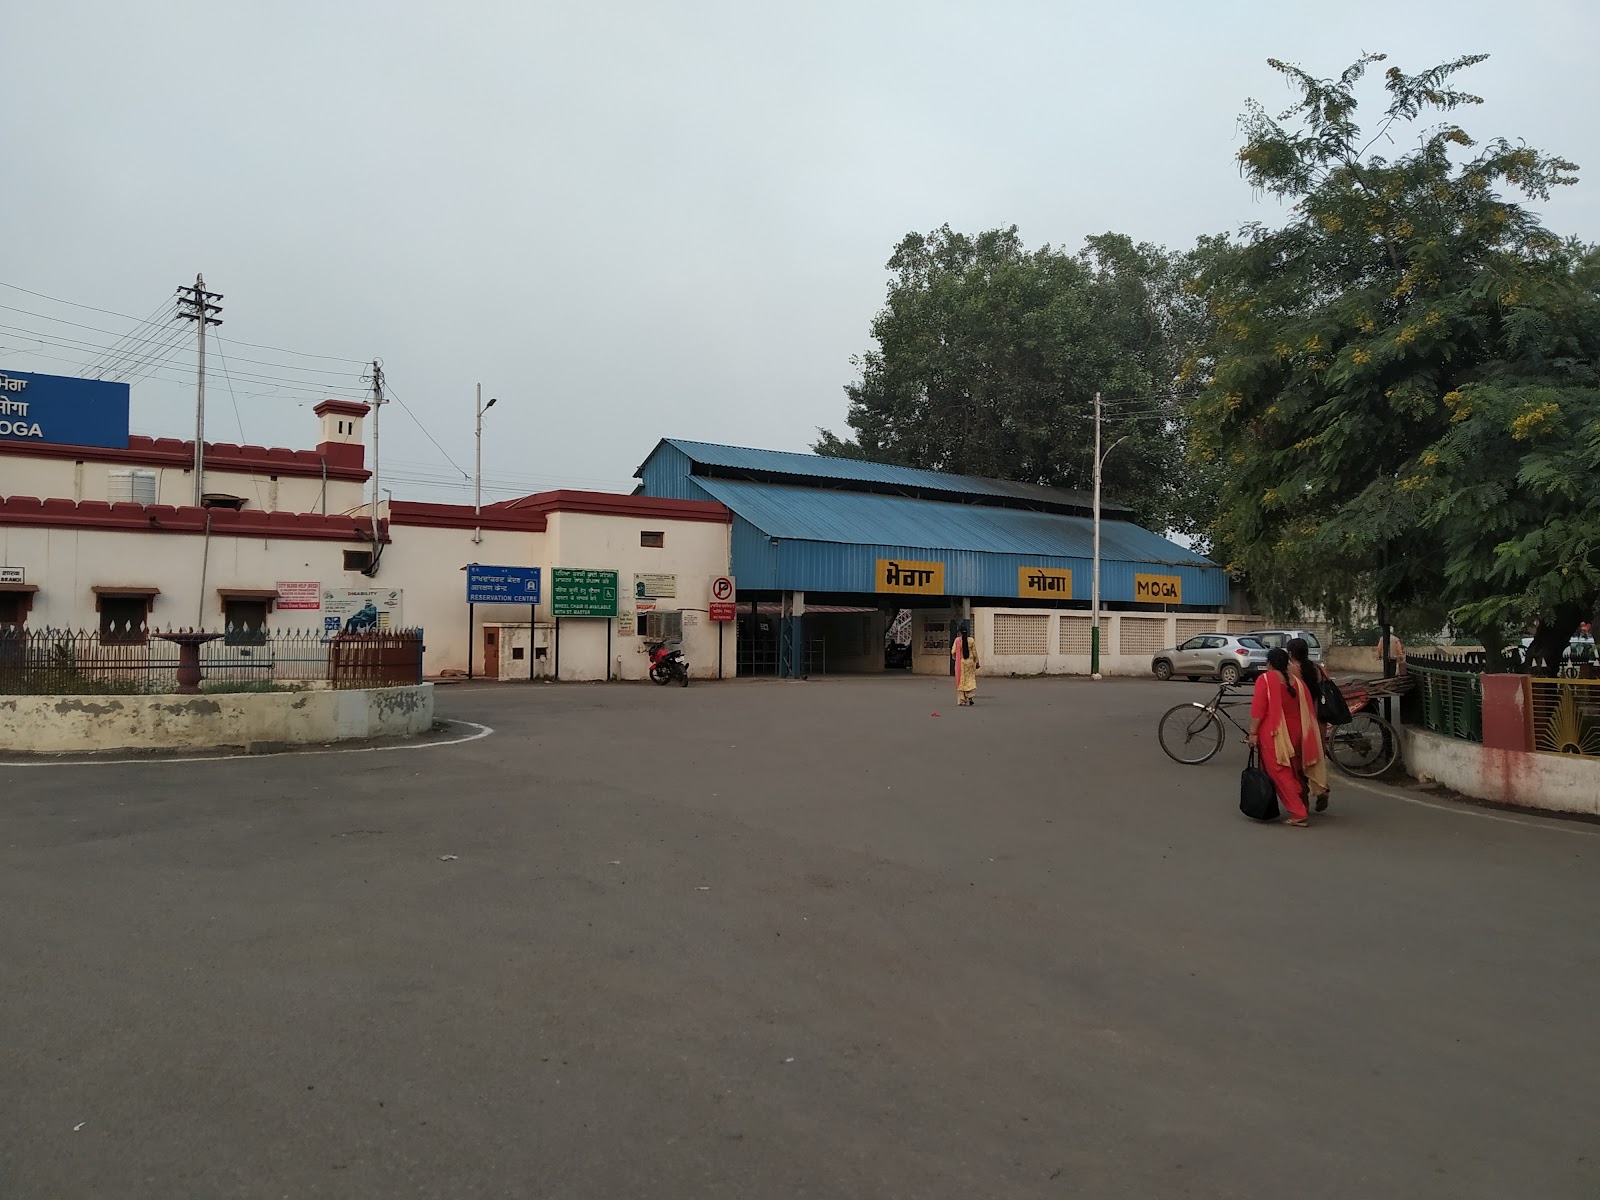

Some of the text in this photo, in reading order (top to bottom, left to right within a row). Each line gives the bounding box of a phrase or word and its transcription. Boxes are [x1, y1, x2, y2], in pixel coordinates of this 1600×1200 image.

[887, 562, 934, 586] ਮੋਗਾ
[1028, 570, 1066, 591] मोगा
[1137, 580, 1177, 597] MOGA
